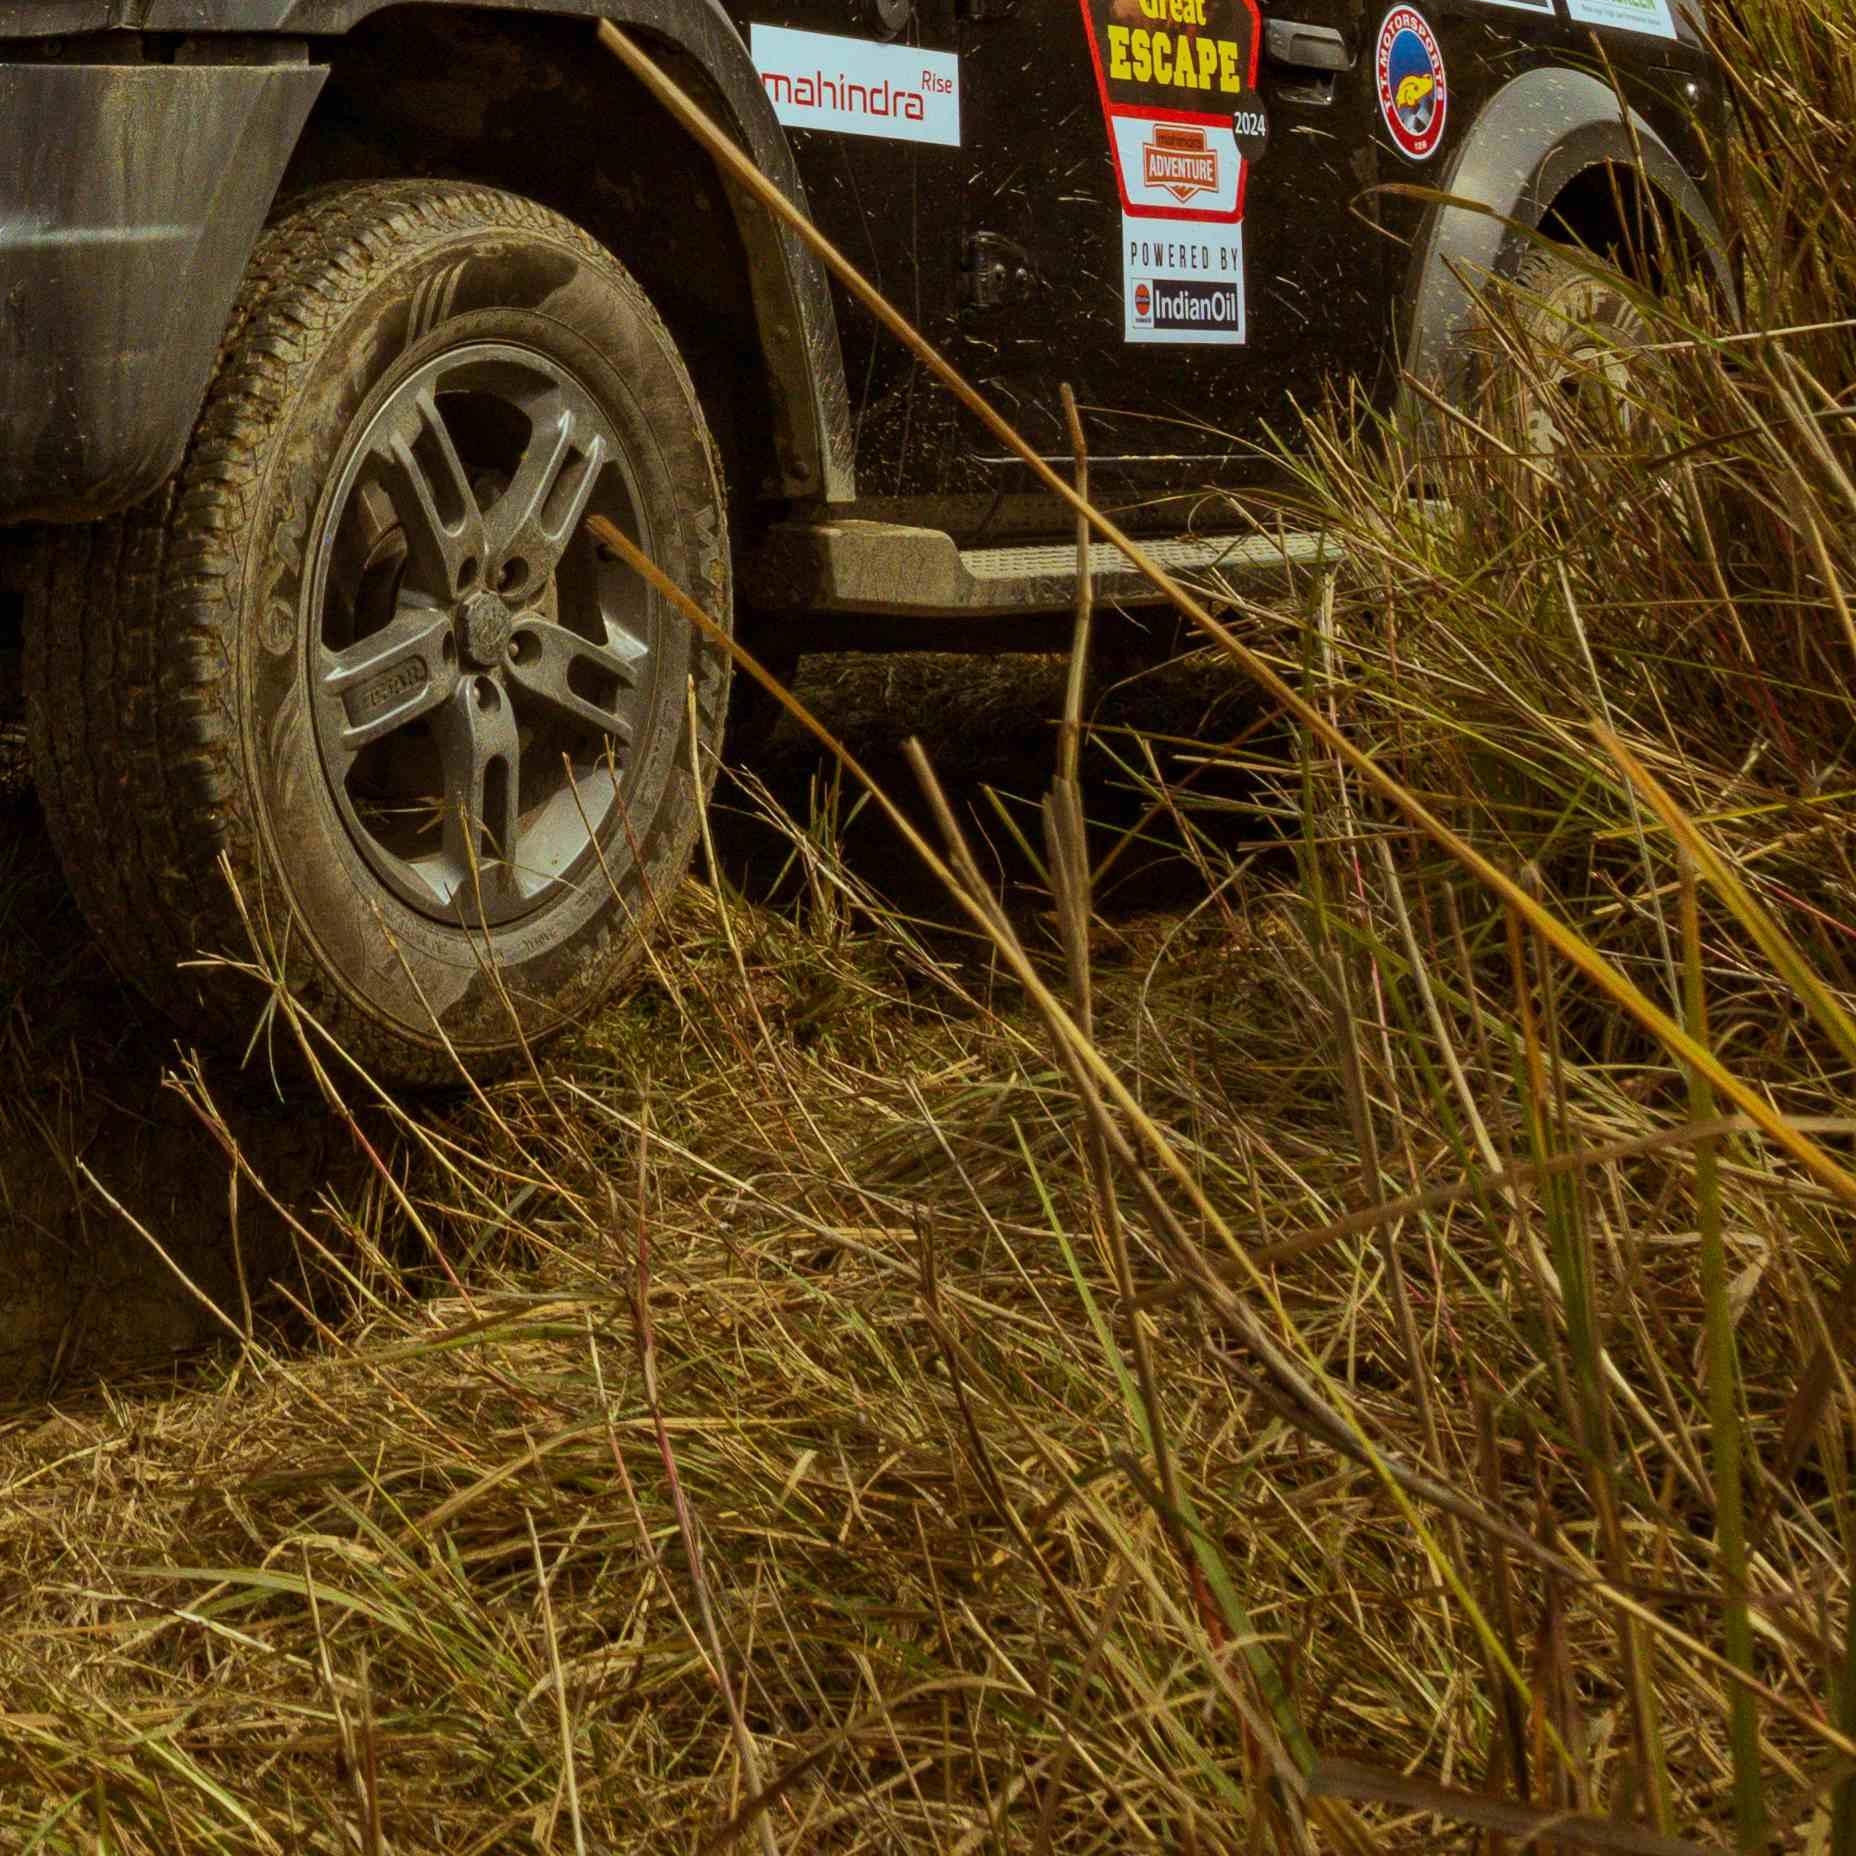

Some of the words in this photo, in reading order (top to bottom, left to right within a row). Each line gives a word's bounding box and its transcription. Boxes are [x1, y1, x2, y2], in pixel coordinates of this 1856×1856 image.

[1107, 24, 1241, 93] ESCAPE
[761, 70, 924, 121] mahindra
[921, 69, 953, 94] Rise
[1234, 111, 1266, 137] 2024
[1148, 154, 1214, 182] ADVENTURE
[1130, 241, 1209, 270] POWERED
[1220, 246, 1239, 271] BY
[1155, 289, 1236, 322] IndianOil
